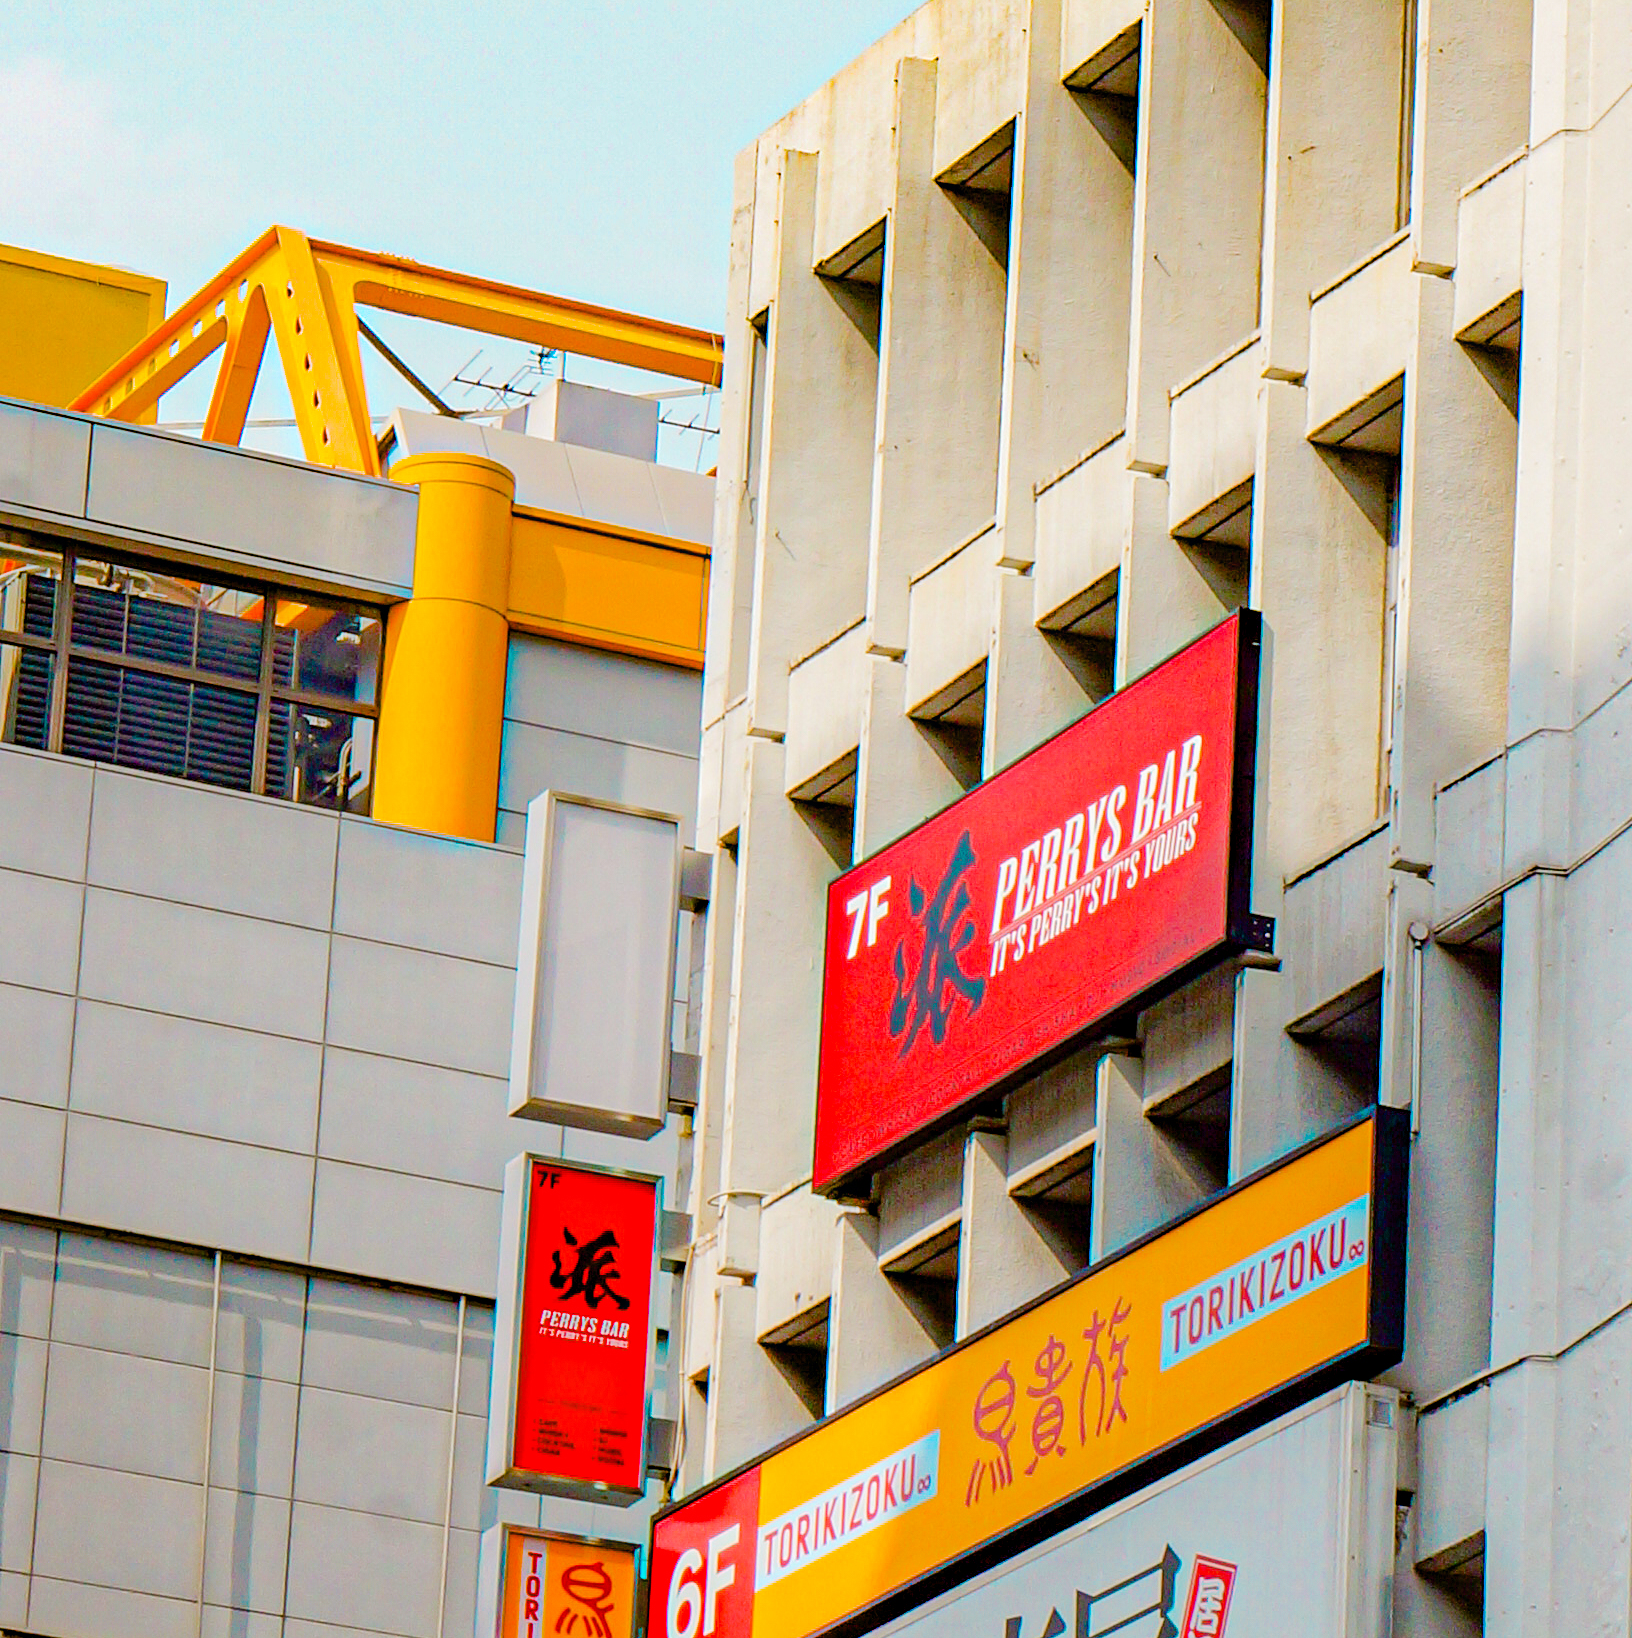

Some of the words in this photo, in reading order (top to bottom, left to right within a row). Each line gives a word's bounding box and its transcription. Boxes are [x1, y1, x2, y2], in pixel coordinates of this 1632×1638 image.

[989, 927, 1027, 978] IT'S
[1027, 879, 1101, 956] PERRY'S
[1101, 845, 1140, 907] IT'S
[1142, 810, 1198, 869] YOURS
[991, 781, 1125, 937] PERRYS
[1132, 733, 1203, 842] BAR
[844, 874, 892, 961] 7F
[888, 829, 986, 1059] 派
[537, 1169, 561, 1190] 7F
[539, 1309, 598, 1334] PERRYS
[600, 1320, 631, 1340] BAR
[549, 1226, 631, 1311] 派
[1168, 1215, 1347, 1355] TORIKIZOKU
[763, 1453, 916, 1577] TORIKIZOKU
